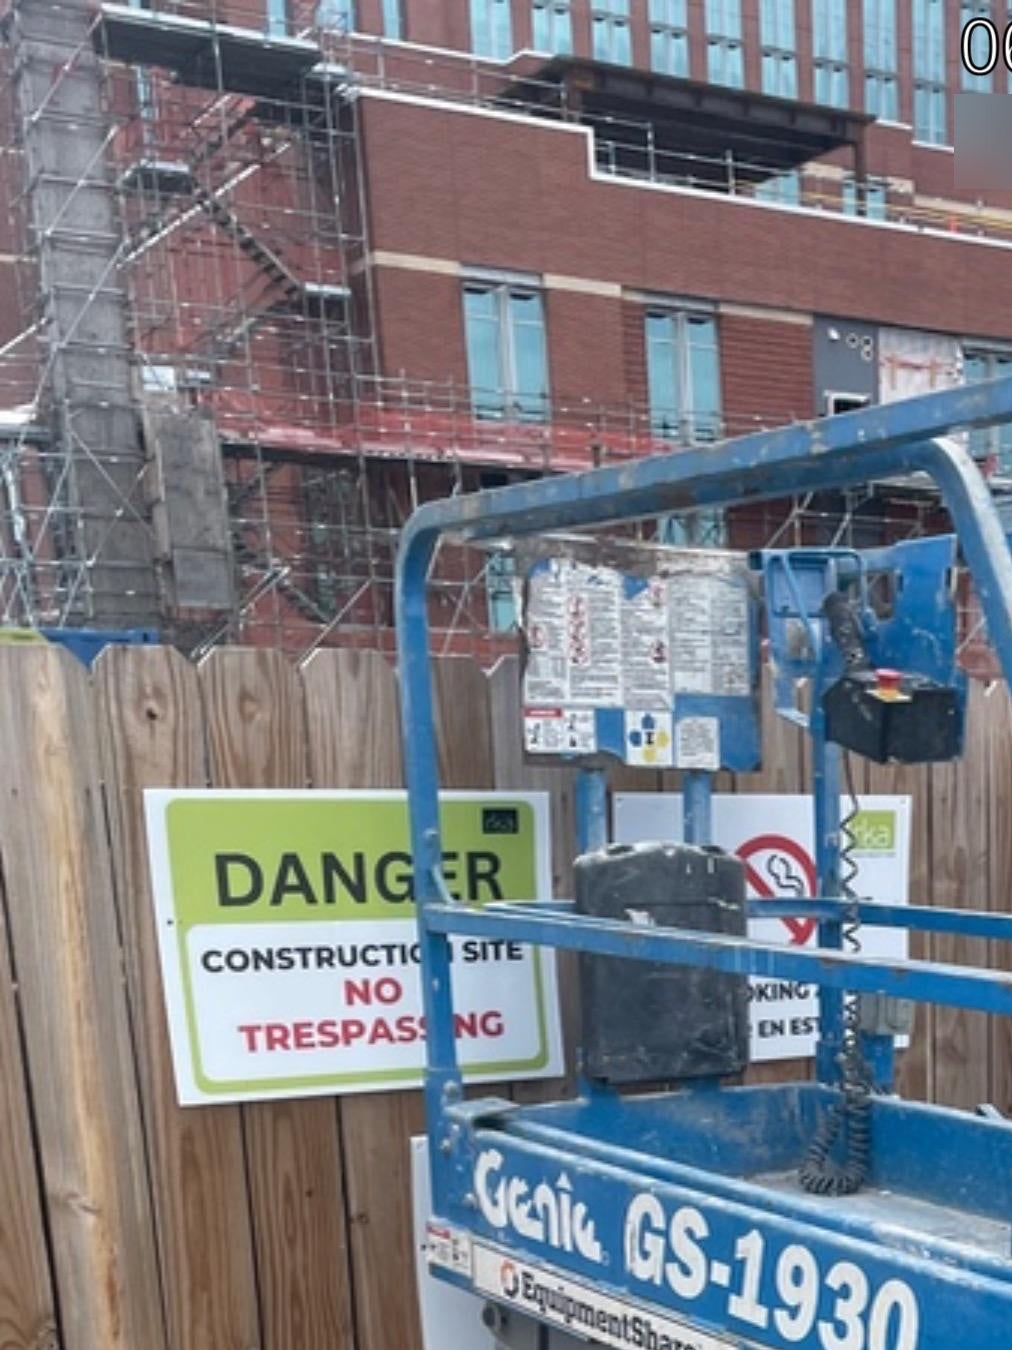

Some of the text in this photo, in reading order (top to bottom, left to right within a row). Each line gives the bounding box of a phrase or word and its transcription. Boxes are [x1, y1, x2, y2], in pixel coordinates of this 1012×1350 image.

[462, 939, 523, 963] SITE
[343, 977, 403, 1006] NO
[237, 1010, 504, 1054] TRESPASNG
[758, 1020, 784, 1038] EN
[474, 1148, 602, 1264] Genie
